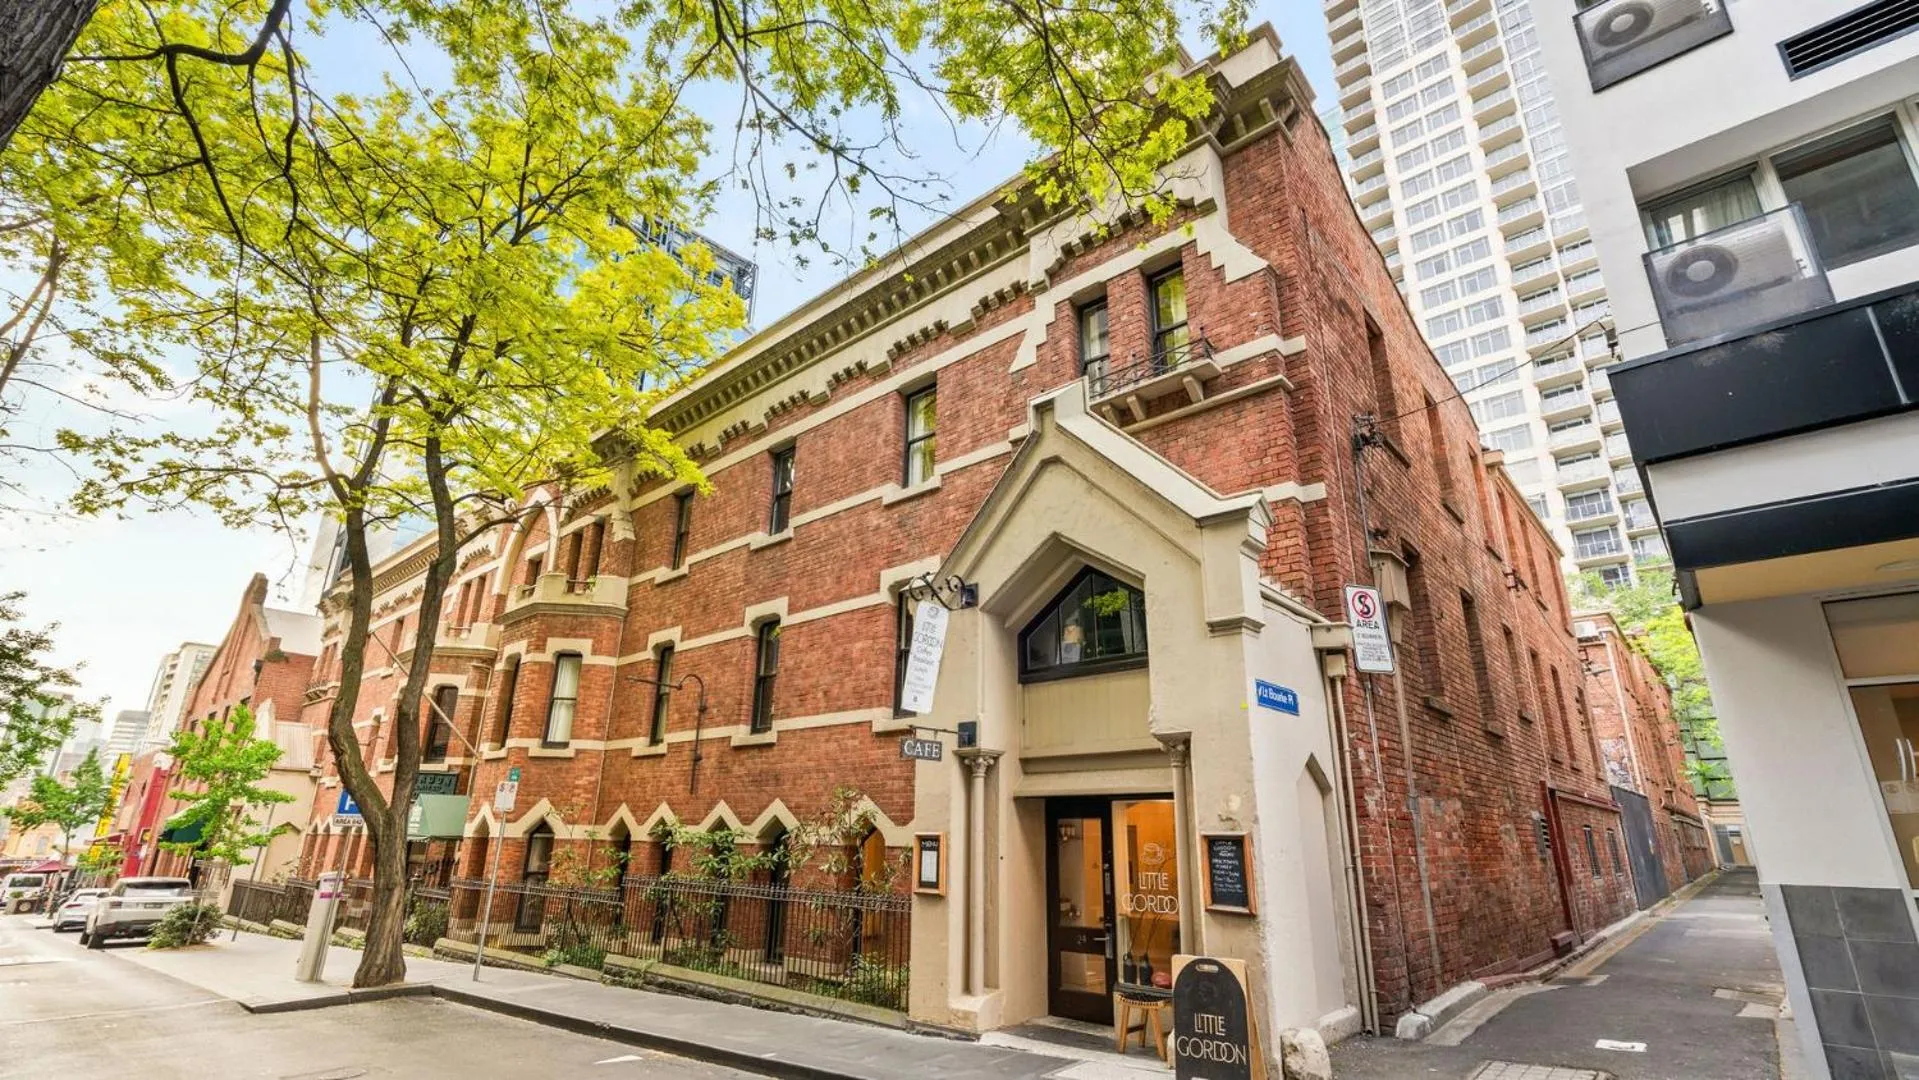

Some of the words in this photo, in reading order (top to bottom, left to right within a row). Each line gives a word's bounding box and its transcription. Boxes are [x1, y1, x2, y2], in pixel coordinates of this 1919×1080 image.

[1356, 618, 1380, 630] AREA
[903, 740, 940, 758] CAFE
[1138, 872, 1169, 891] LITTLE
[1121, 892, 1178, 915] GORDO
[1194, 1012, 1227, 1036] LITTLE
[1176, 1036, 1248, 1066] GORDON
